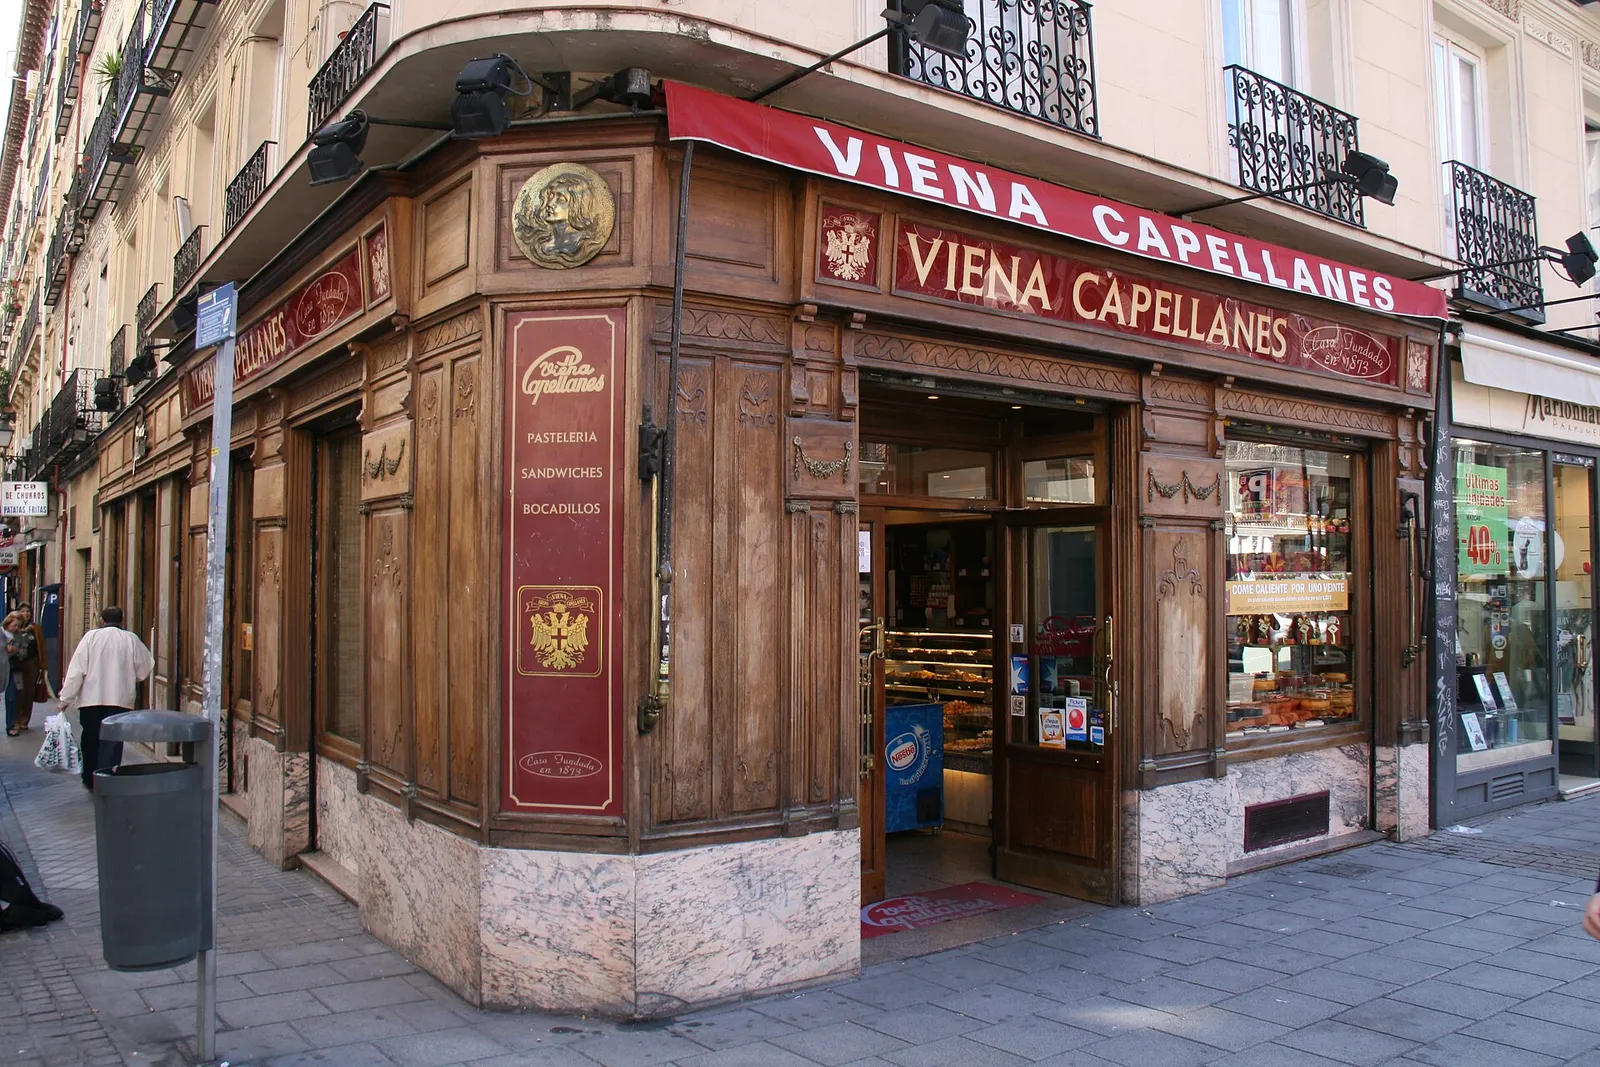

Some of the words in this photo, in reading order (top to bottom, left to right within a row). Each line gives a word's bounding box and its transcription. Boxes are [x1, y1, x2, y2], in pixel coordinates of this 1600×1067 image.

[813, 126, 1049, 226] VIENA
[1091, 204, 1395, 311] CAPELLANES
[906, 231, 1052, 311] VIENA
[1072, 272, 1288, 363] CAPELLANES
[191, 361, 215, 402] VIEN
[233, 311, 286, 381] PELLANES
[1344, 333, 1384, 368] Fundada
[541, 355, 595, 377] Viena
[527, 431, 598, 444] PASTELERIA
[521, 467, 603, 479] SANDWICHES
[1465, 491, 1505, 507] unidades
[523, 503, 601, 515] BOCADILLOS
[1232, 585, 1254, 595] COME
[1256, 584, 1288, 594] CALIENTE
[1291, 583, 1305, 593] POR
[1308, 583, 1323, 593] UNO
[1323, 582, 1345, 592] VEINTE
[50, 594, 58, 603] P
[527, 756, 548, 767] Casa
[554, 754, 595, 771] Fundada
[559, 765, 582, 777] 1873
